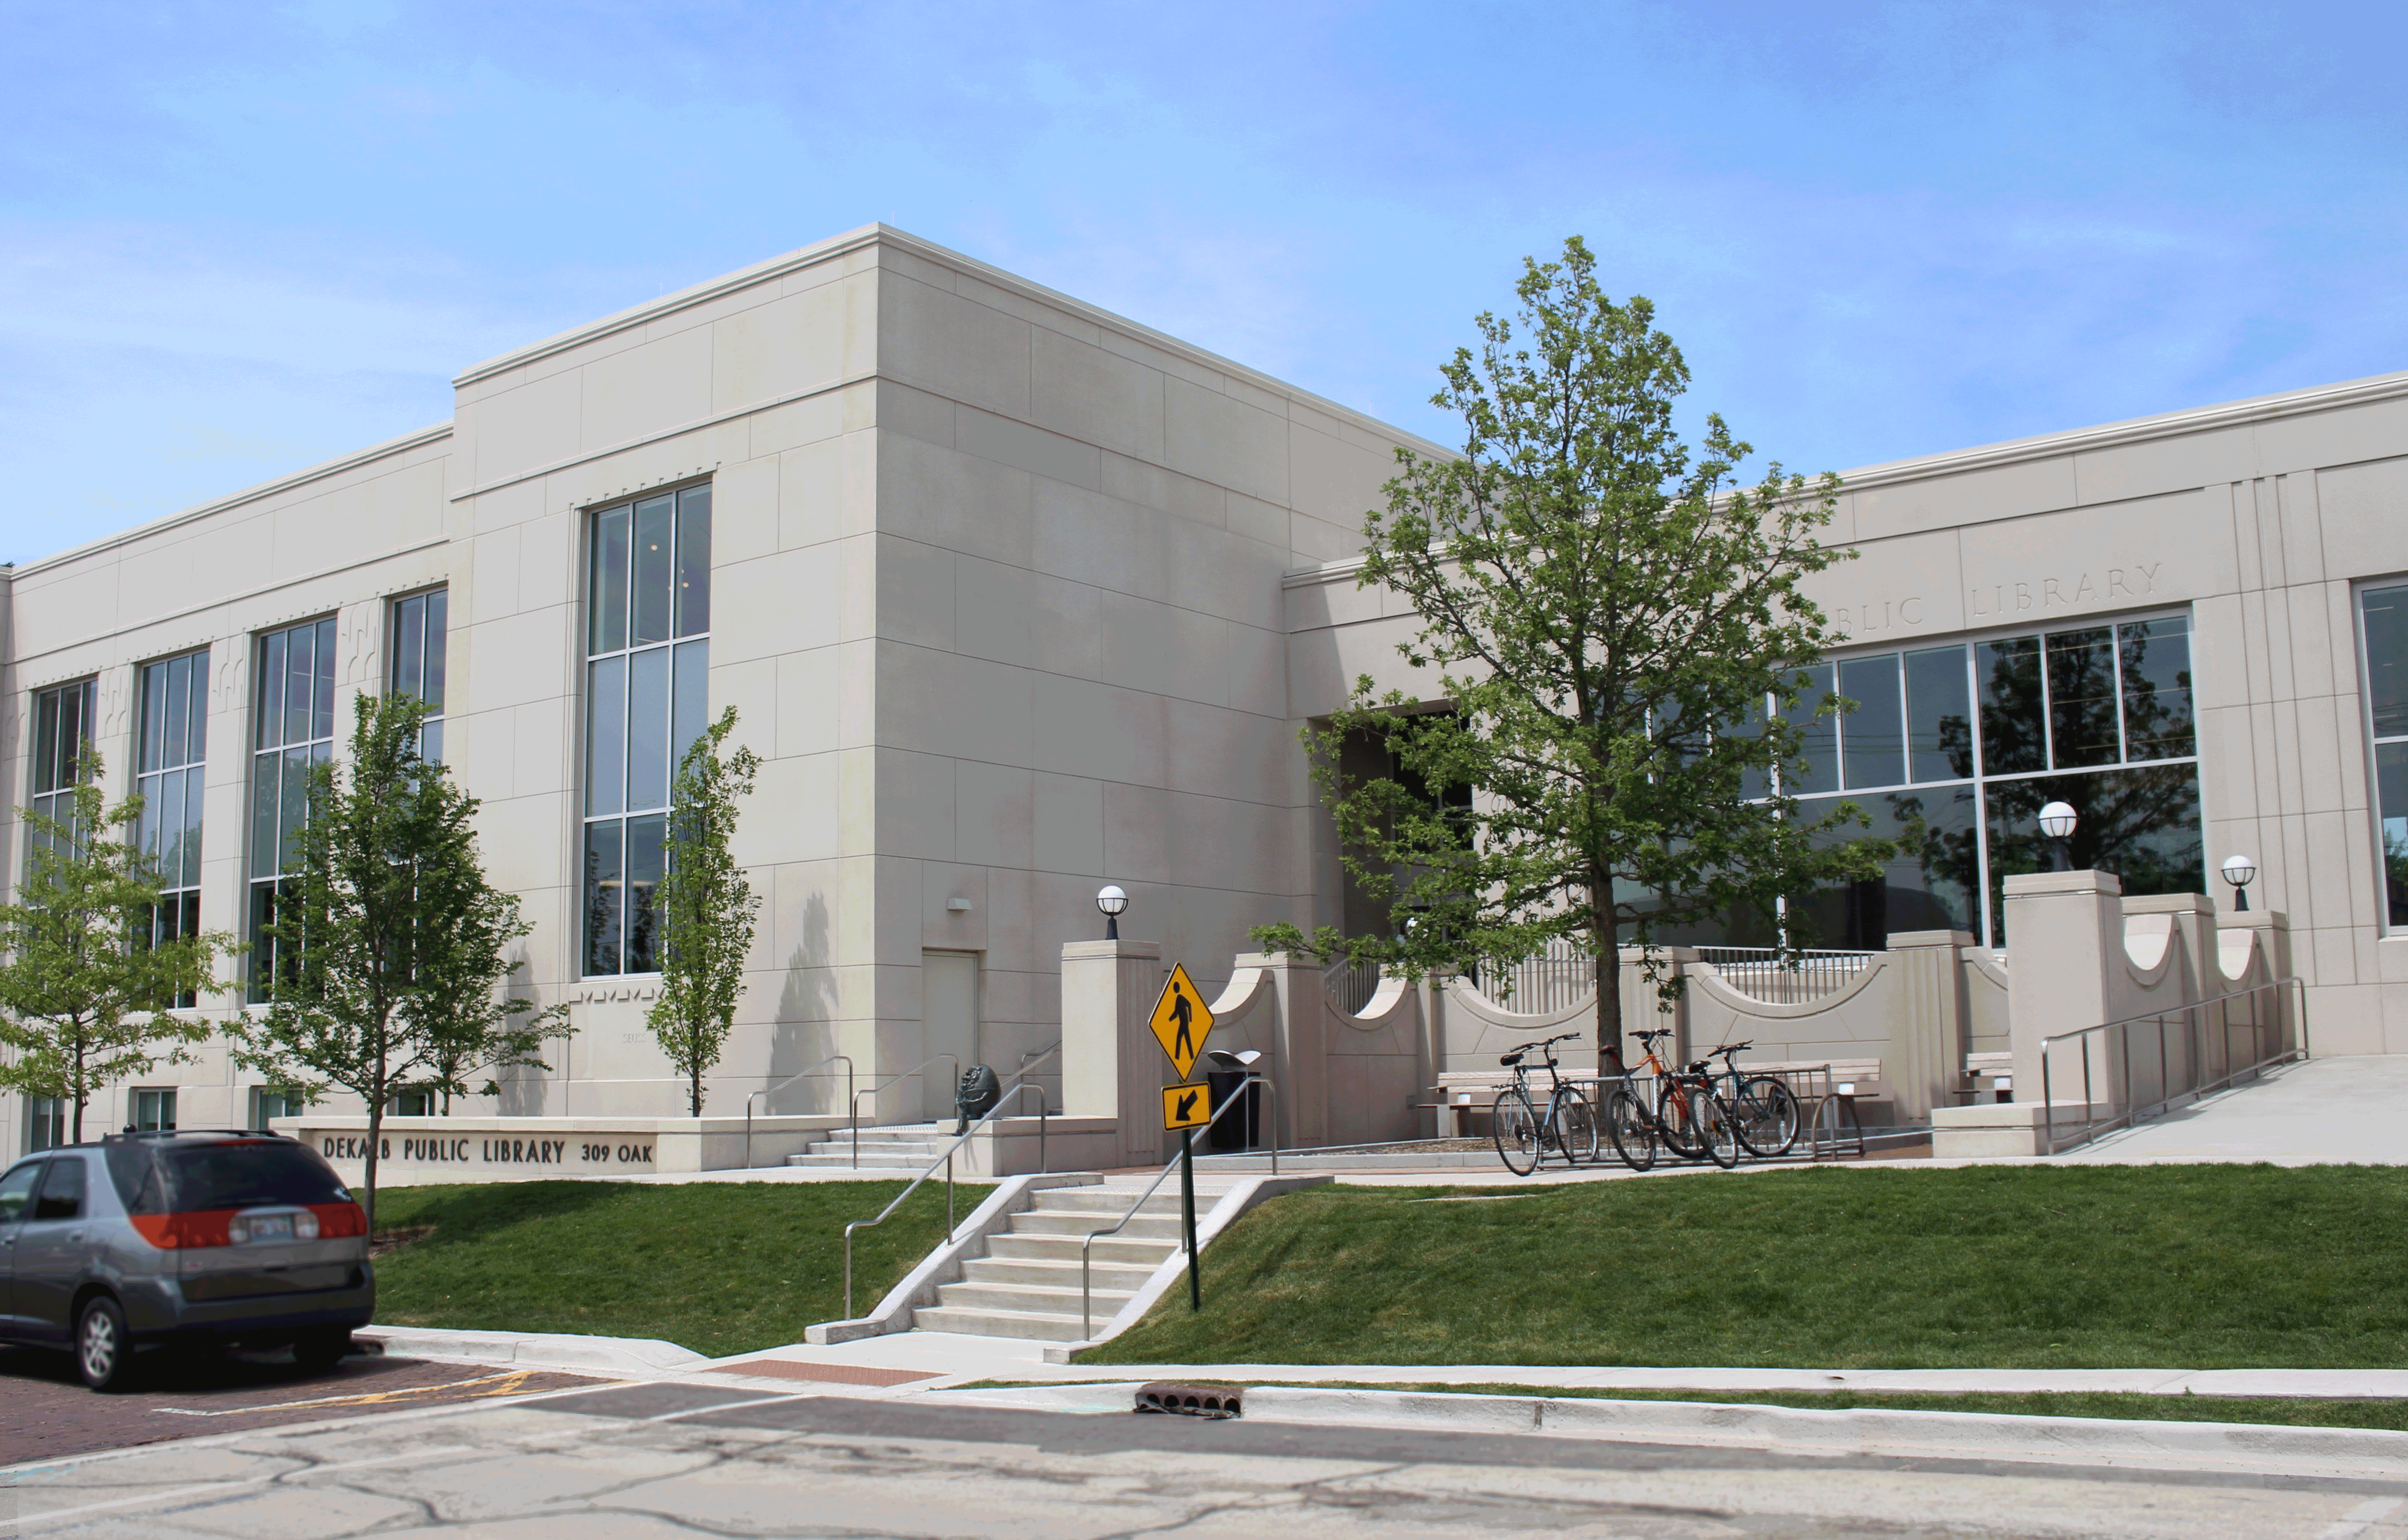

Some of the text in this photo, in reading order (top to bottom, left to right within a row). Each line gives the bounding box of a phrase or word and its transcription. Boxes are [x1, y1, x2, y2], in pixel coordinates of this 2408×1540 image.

[1780, 562, 2162, 644] BLIC LIBRARY
[622, 1033, 646, 1044] SEUSS
[324, 1137, 653, 1163] DEKAB PUBLIC LIBRARY 309 OAK
